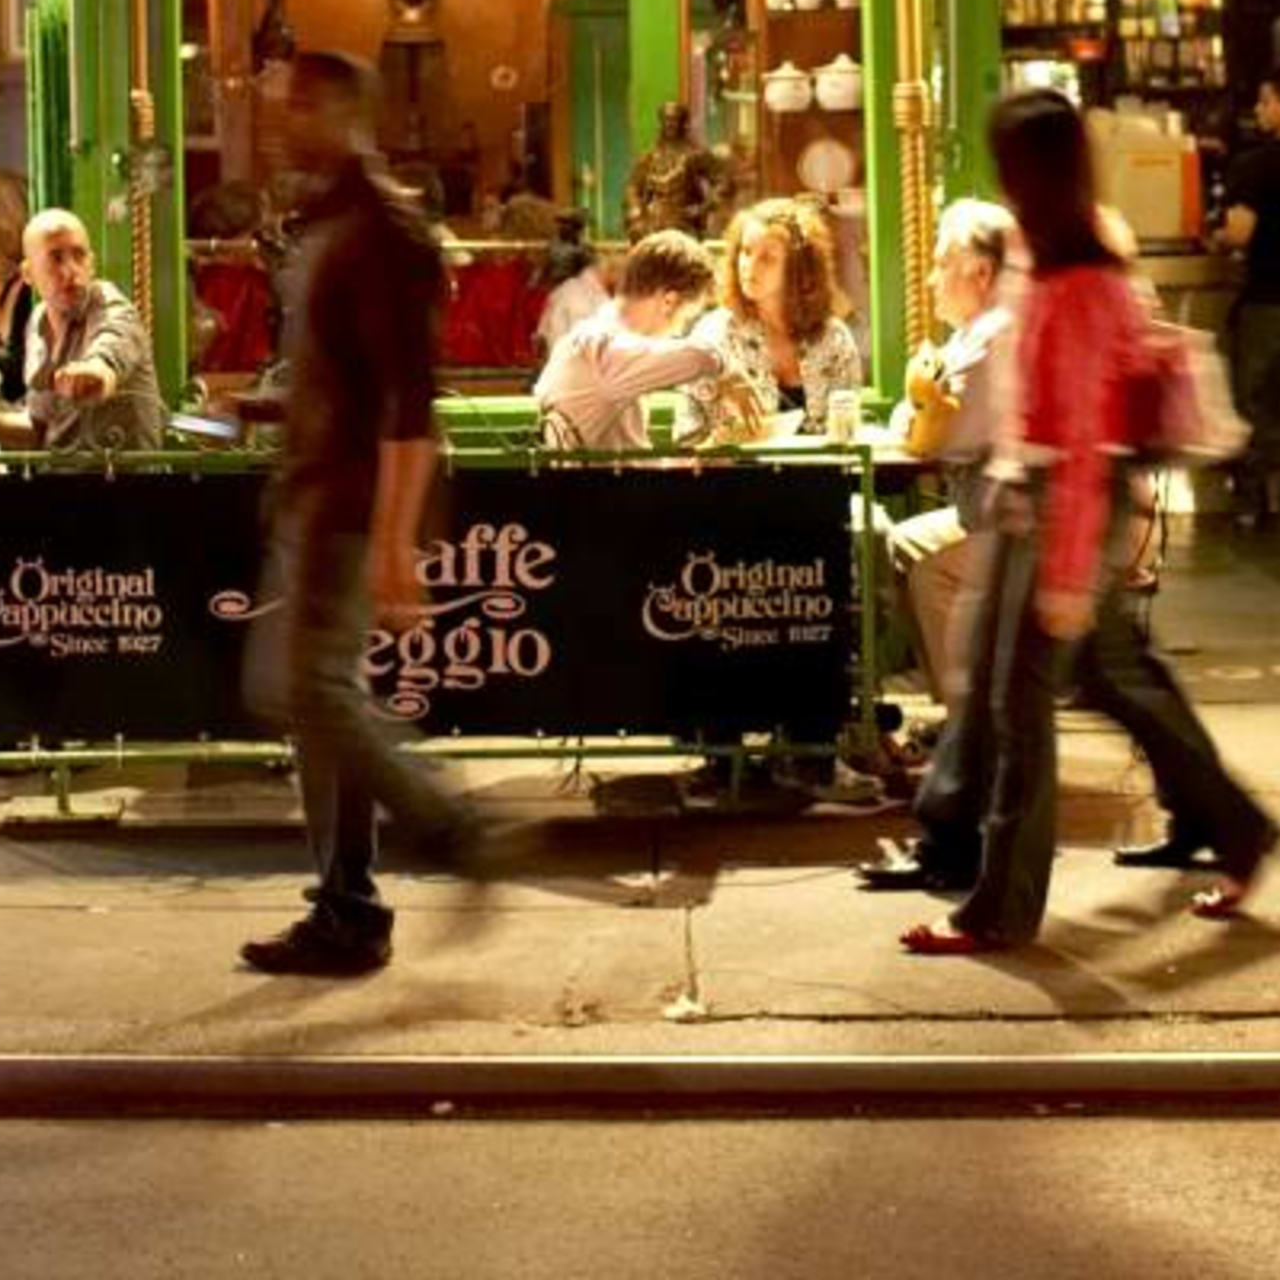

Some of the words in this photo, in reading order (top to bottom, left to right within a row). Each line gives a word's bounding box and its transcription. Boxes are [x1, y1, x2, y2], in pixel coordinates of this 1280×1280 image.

[10, 555, 155, 602] Original
[412, 523, 557, 602] affe
[682, 551, 826, 596] Original
[642, 581, 833, 641] Cappuccino
[49, 633, 109, 657] Since
[361, 616, 552, 704] eggio
